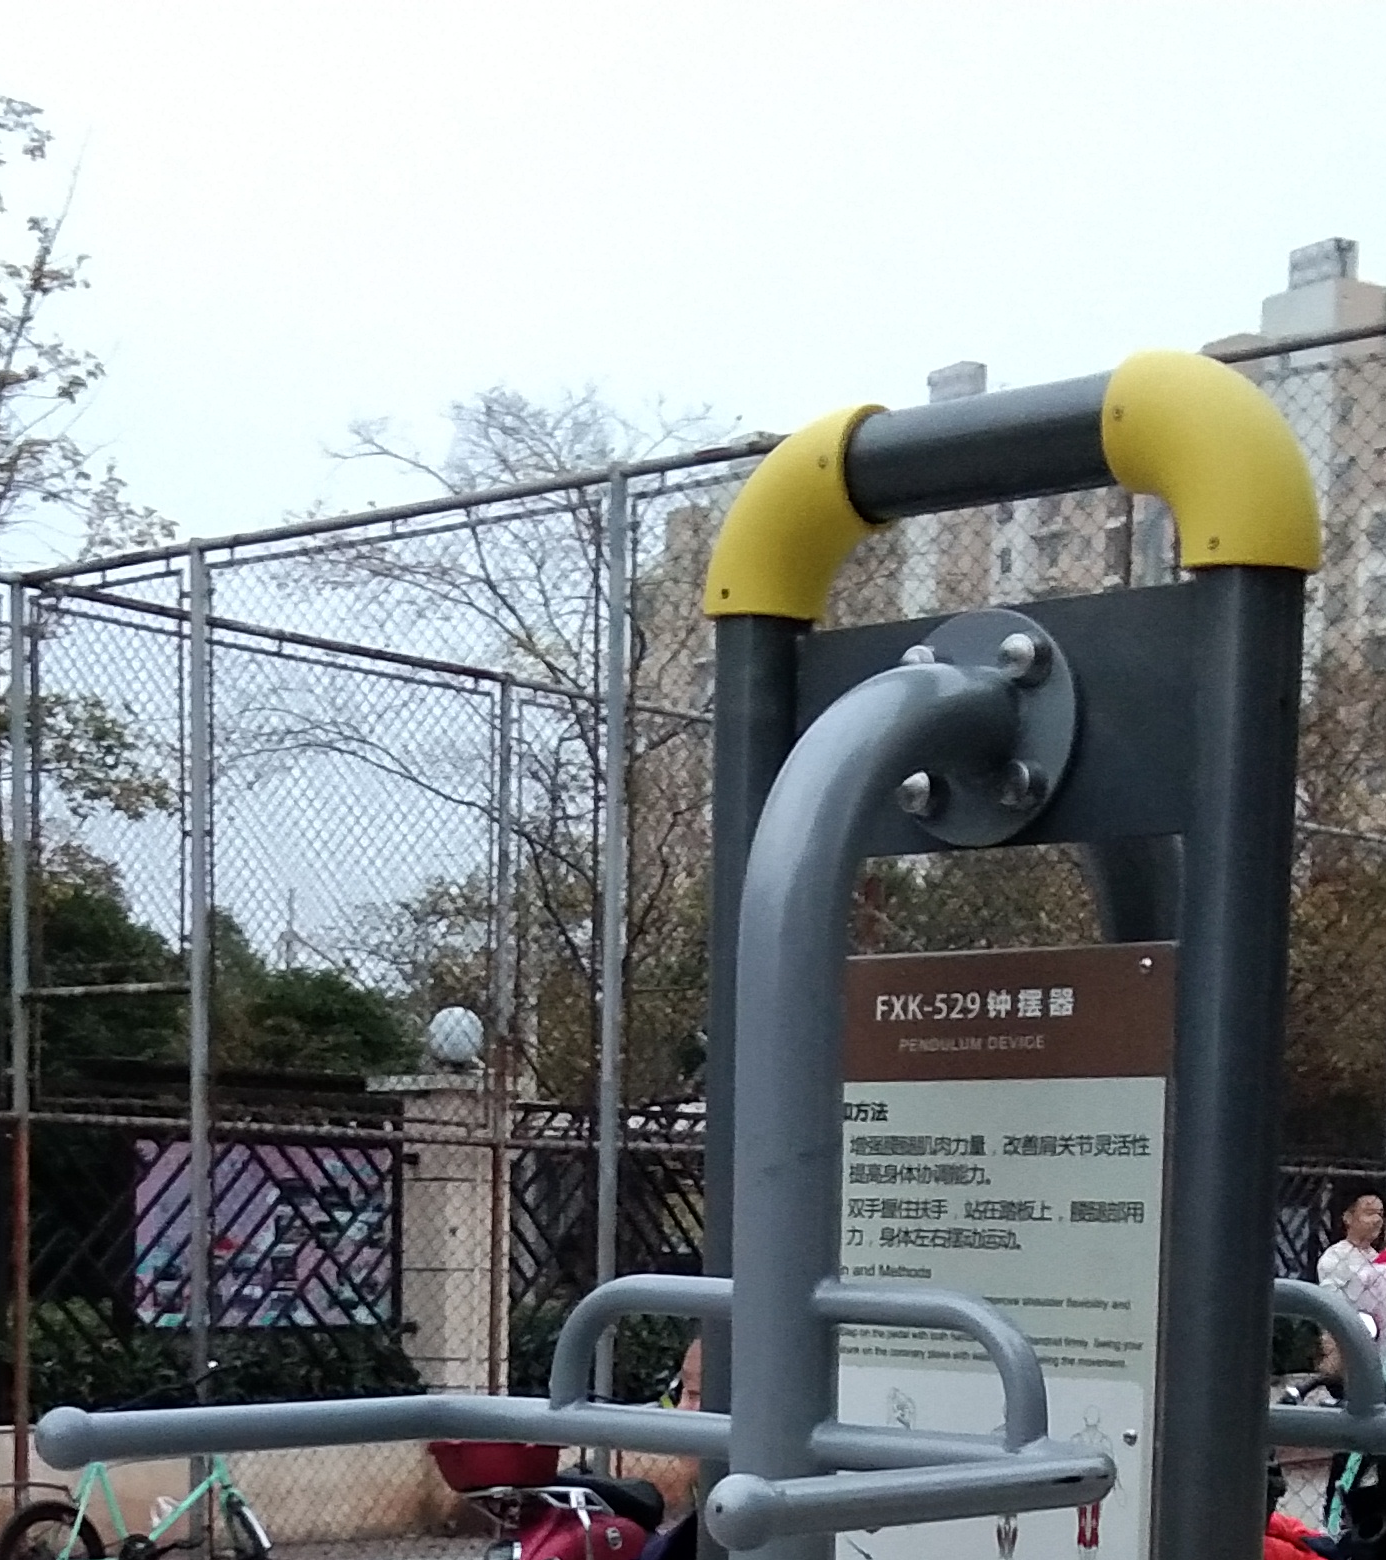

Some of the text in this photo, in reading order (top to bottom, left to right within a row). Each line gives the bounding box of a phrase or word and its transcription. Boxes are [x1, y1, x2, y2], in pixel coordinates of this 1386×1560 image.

[875, 986, 1076, 1021] FXK-529 钟摆器
[987, 1034, 1046, 1051] DEVICE
